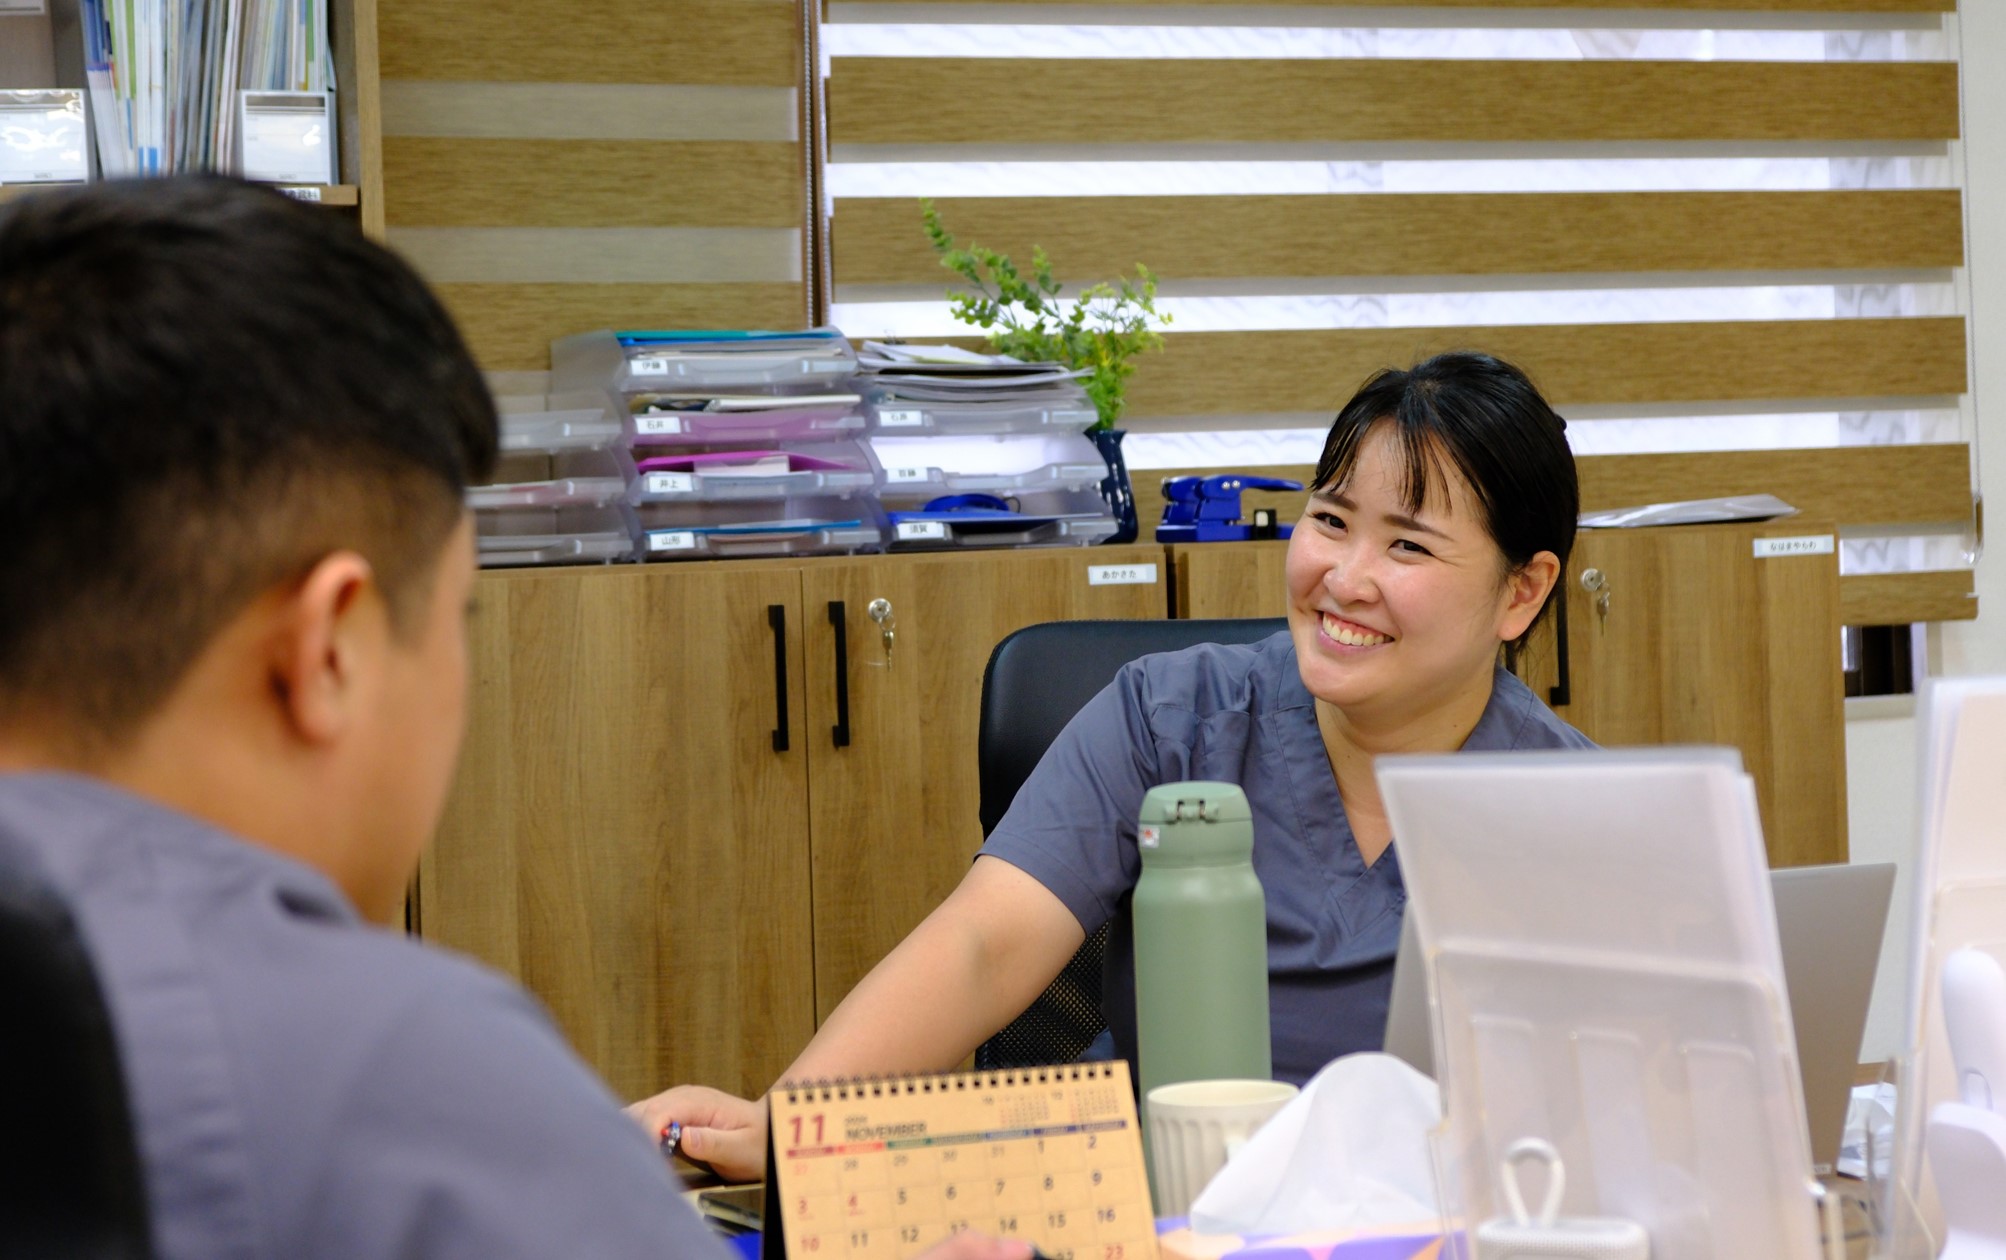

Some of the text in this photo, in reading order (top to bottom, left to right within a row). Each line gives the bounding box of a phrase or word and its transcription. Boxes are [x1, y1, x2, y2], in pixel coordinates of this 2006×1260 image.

[1102, 569, 1137, 580] あかさた
[788, 1113, 826, 1146] 11
[846, 1122, 927, 1140] NOVEMBER
[1037, 1139, 1045, 1153] 1
[1088, 1135, 1097, 1149] 2
[798, 1170, 1102, 1214] 3 4 5 6 7 8 9
[800, 1235, 820, 1252] 10
[851, 1230, 869, 1248] 11
[901, 1225, 919, 1243] 12
[1000, 1217, 1018, 1233] 14
[1048, 1212, 1066, 1229] 15
[1098, 1208, 1116, 1223] 16
[1105, 1243, 1125, 1260] 23
